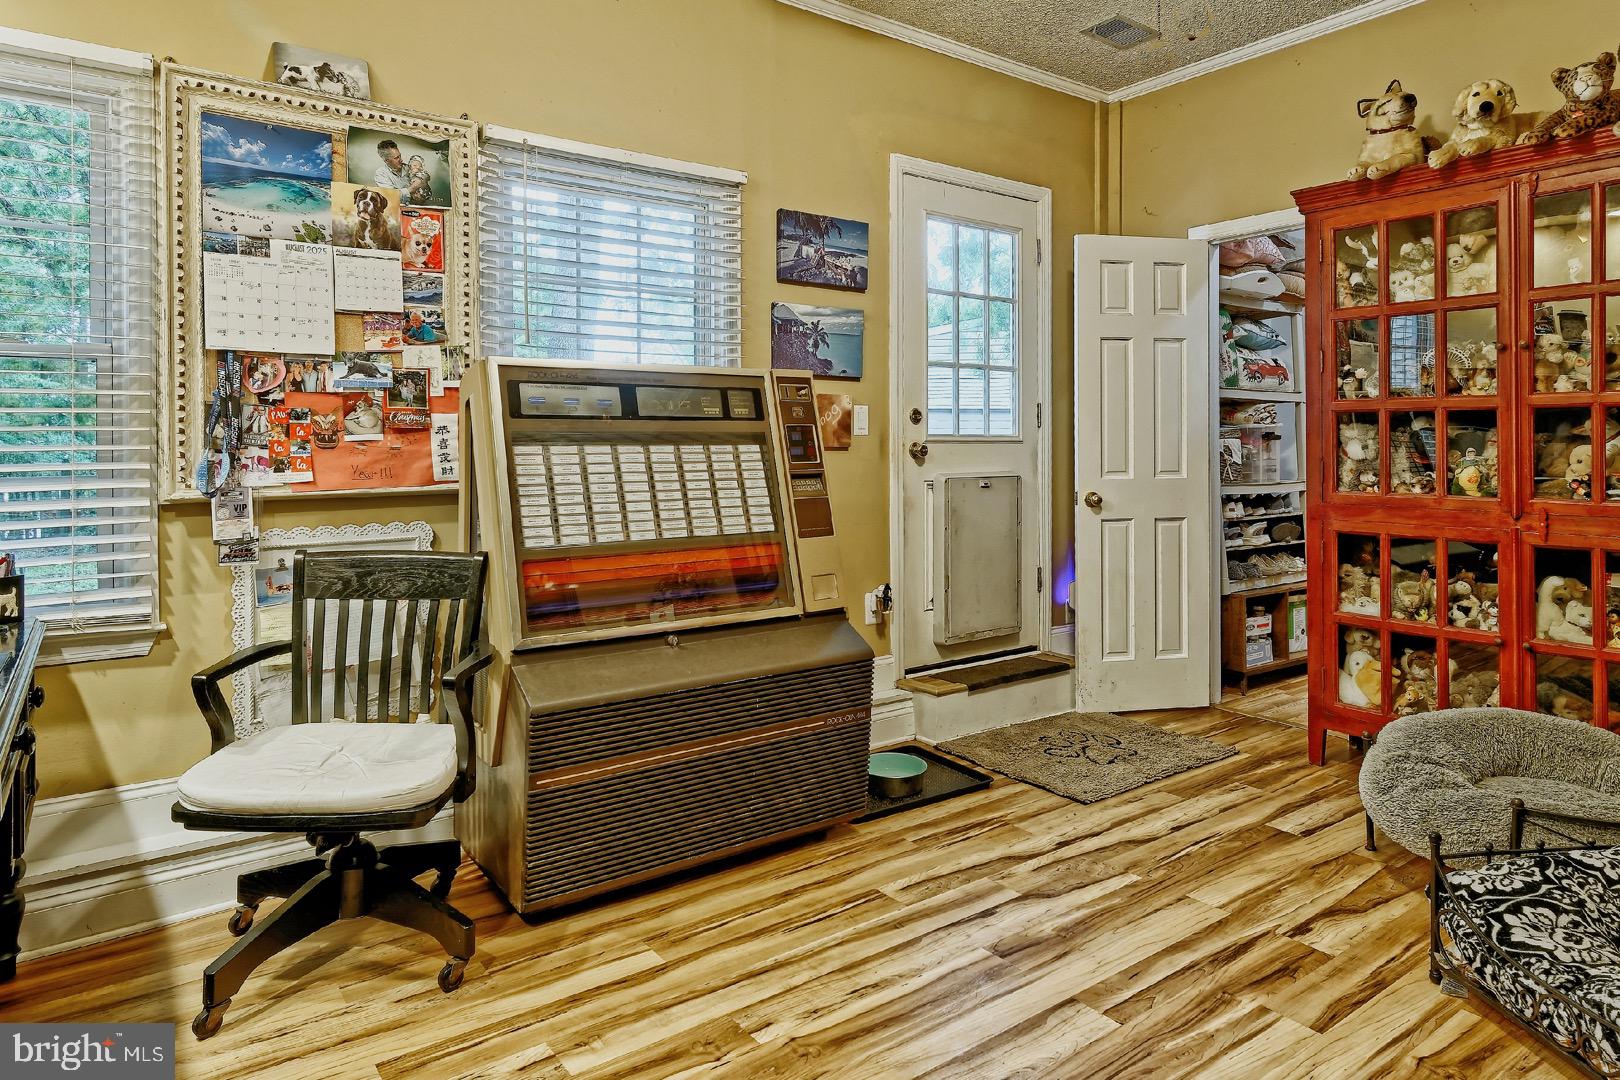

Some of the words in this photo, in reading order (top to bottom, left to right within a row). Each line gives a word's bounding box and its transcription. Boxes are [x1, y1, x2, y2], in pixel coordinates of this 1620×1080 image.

[306, 245, 328, 255] 2025
[273, 443, 286, 452] la
[296, 458, 309, 469] la
[233, 503, 248, 512] VIP
